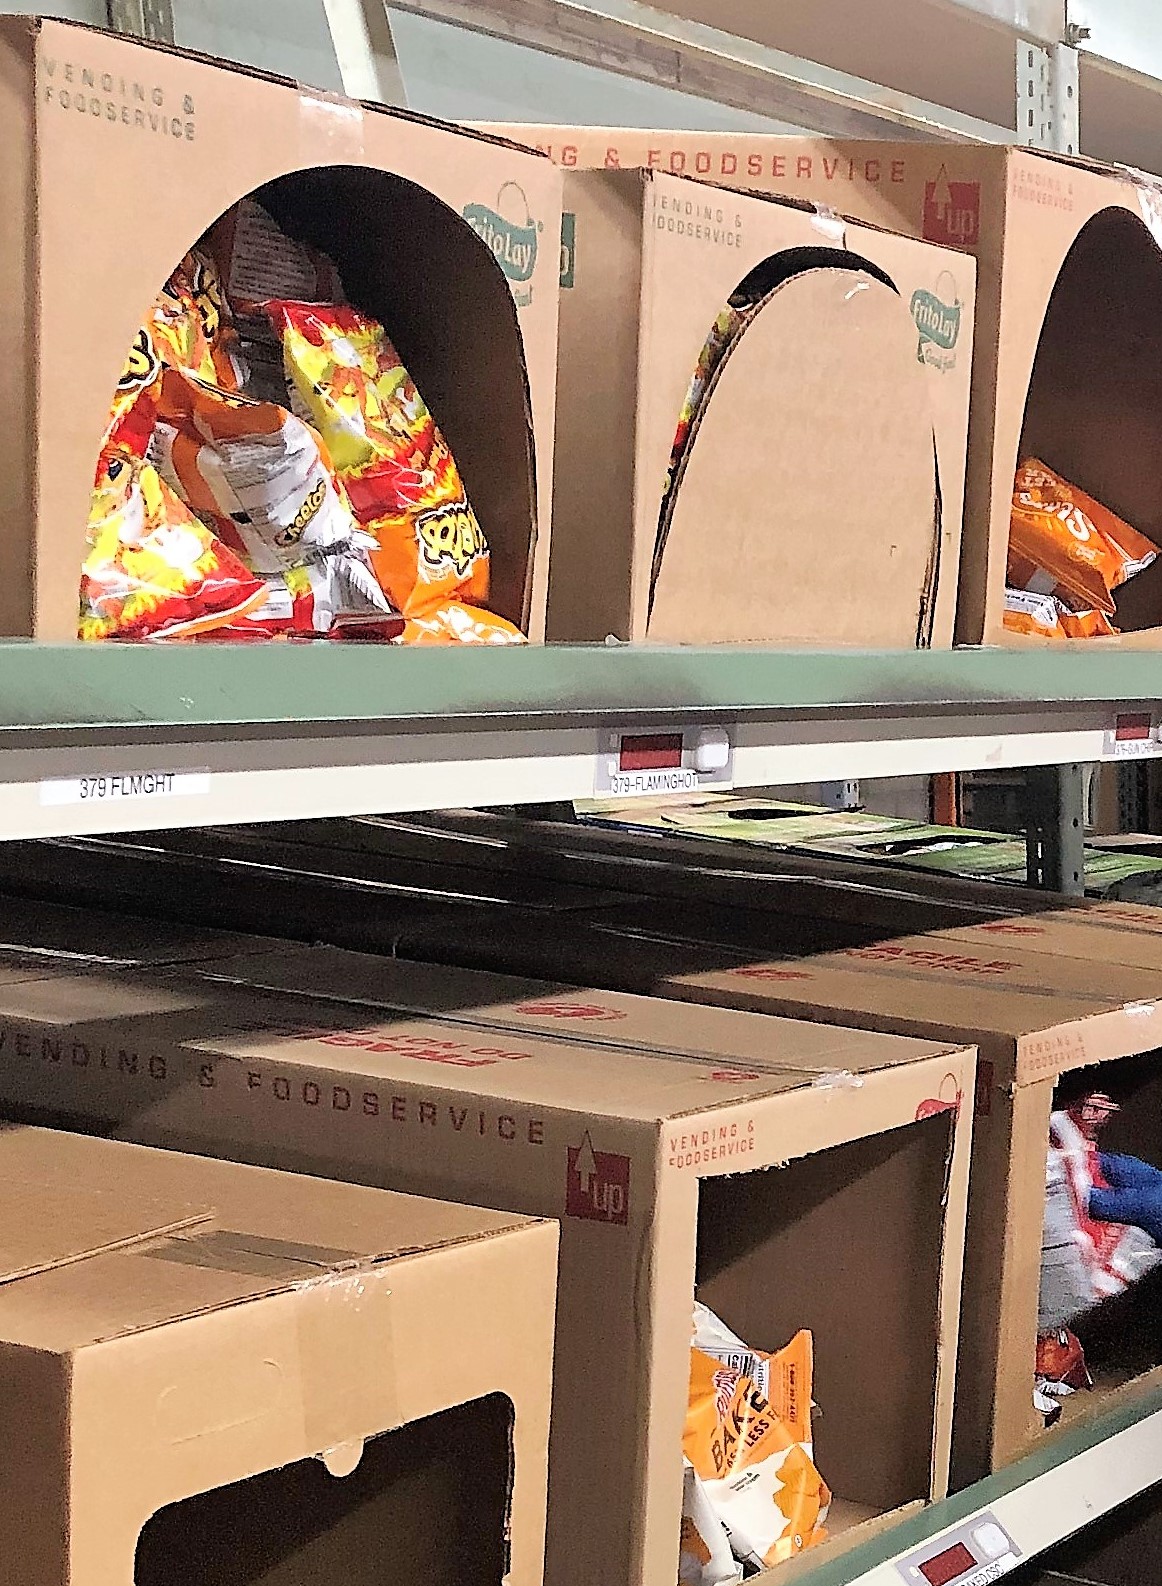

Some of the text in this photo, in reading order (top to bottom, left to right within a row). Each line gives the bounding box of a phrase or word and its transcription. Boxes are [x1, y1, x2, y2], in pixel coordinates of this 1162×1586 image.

[42, 56, 164, 107] VENDING
[45, 86, 195, 141] FOODSERVICE
[646, 149, 906, 184] FOODSERVICE
[653, 195, 723, 223] ENDING
[652, 213, 742, 249] OODSERVICE
[80, 773, 175, 799] 379 FLMGHT
[0, 1031, 168, 1080] ENDING
[247, 1070, 545, 1146] FOODSERVICE
[668, 1137, 755, 1170] FOODSERVICE
[670, 1123, 737, 1153] VENDING
[593, 1182, 624, 1220] up
[744, 1418, 770, 1447] LESS
